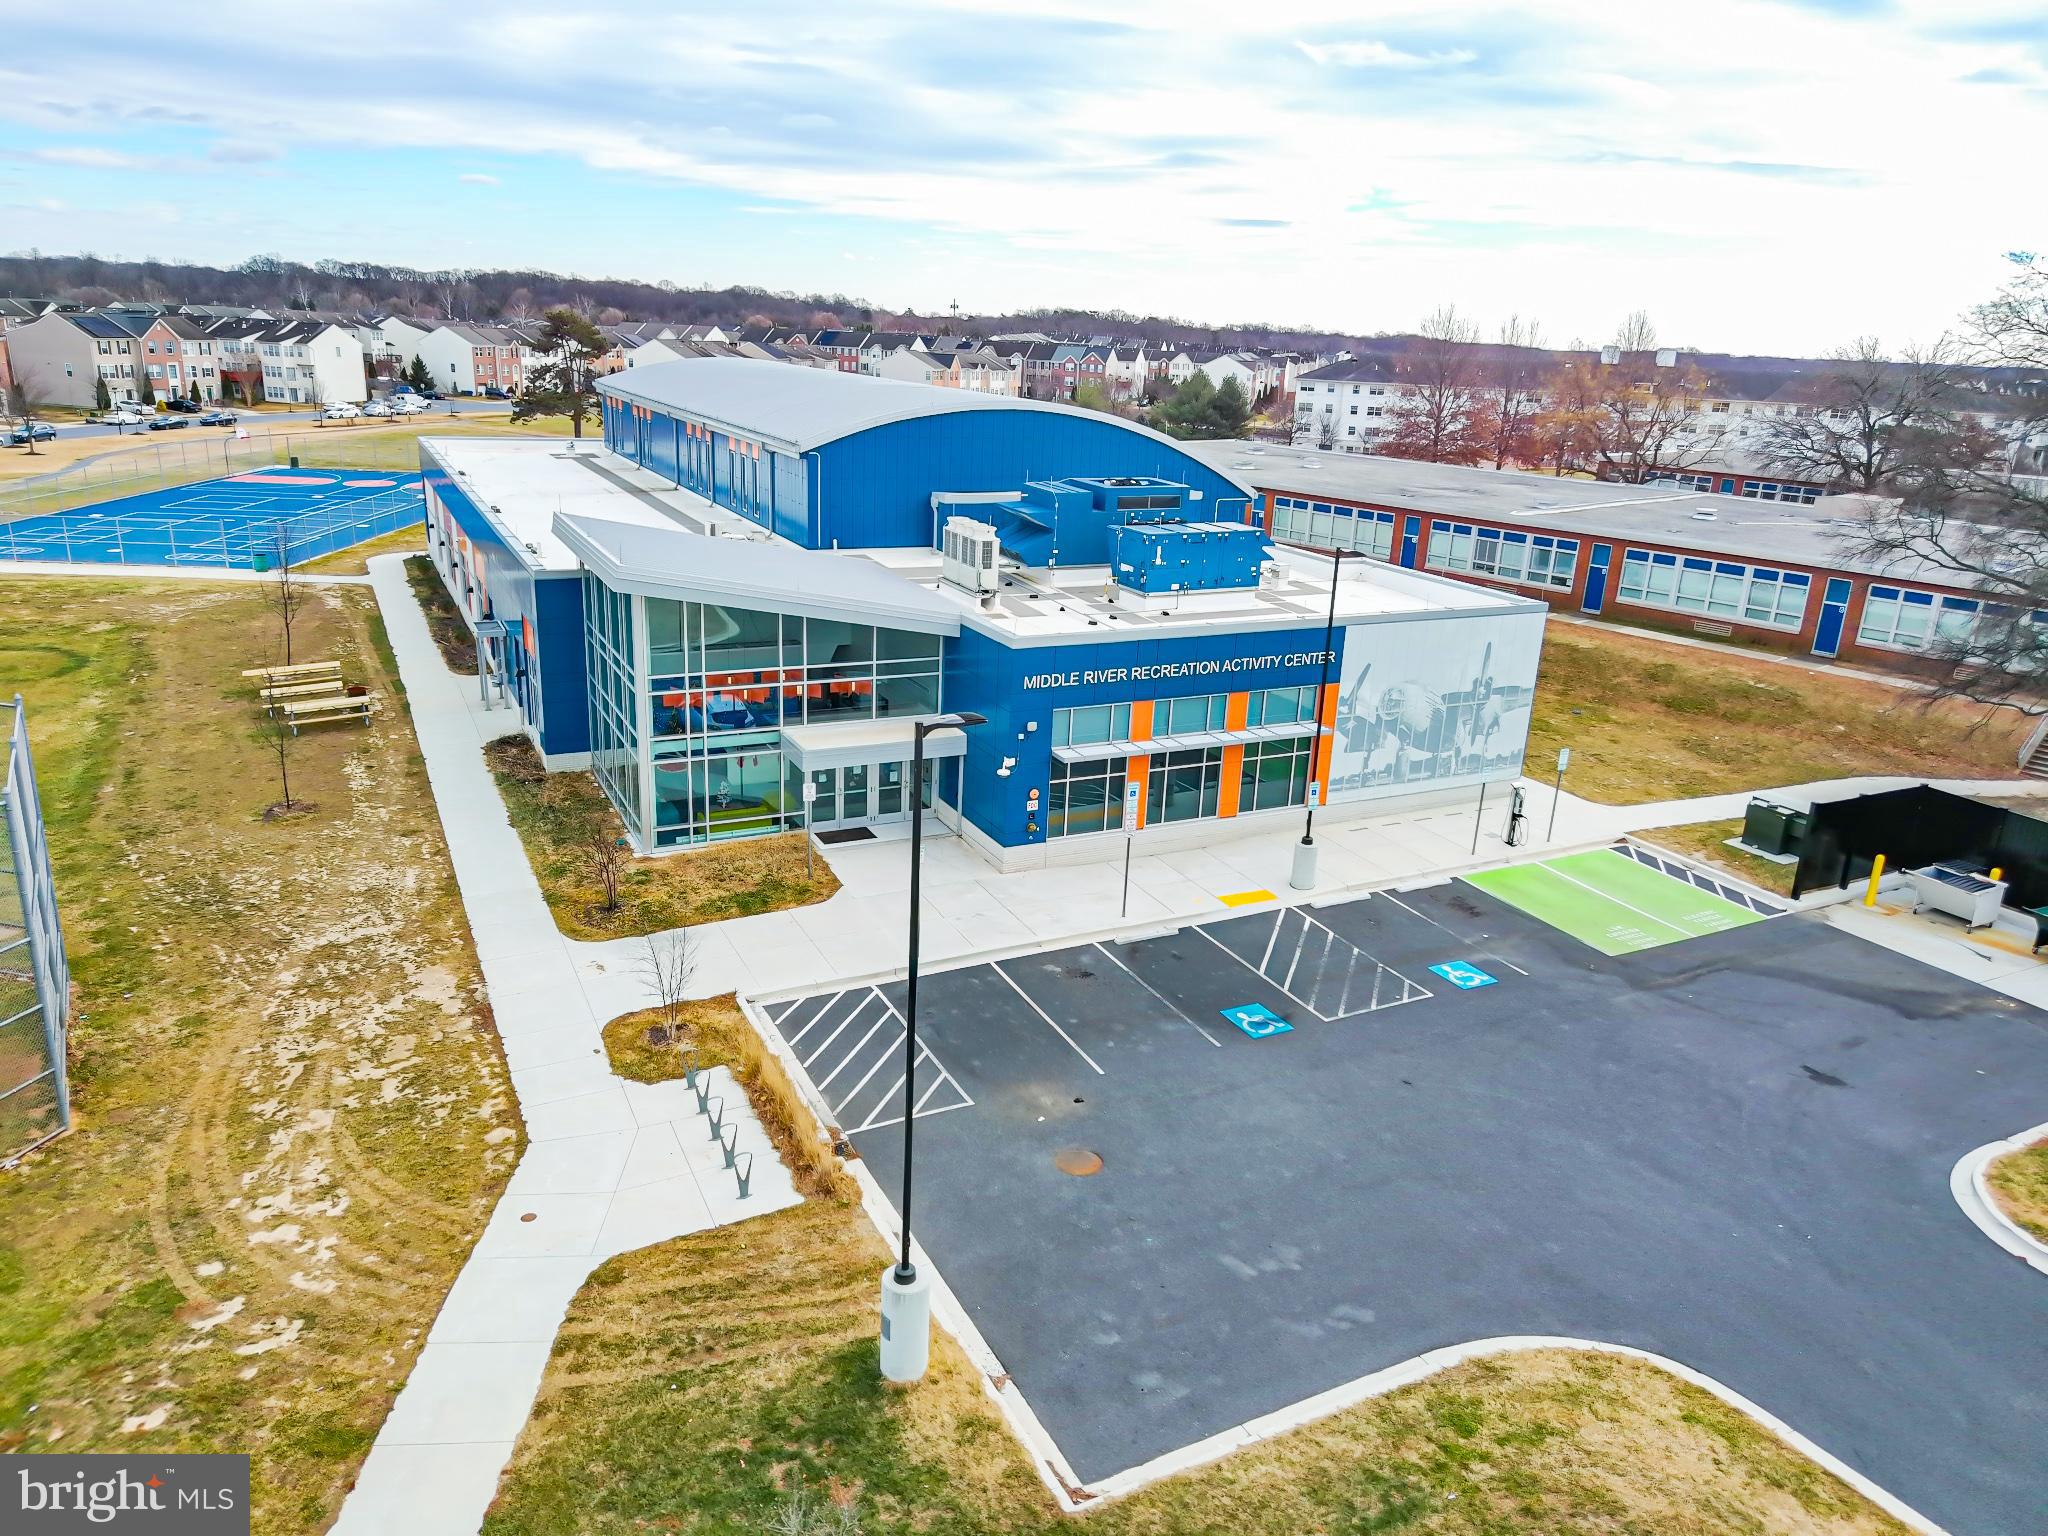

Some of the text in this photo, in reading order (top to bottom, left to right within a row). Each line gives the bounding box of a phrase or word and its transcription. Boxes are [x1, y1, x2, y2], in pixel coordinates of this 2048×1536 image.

[1024, 651, 1336, 690] MIDDLE RIVER RECREATION ACTIVITY CENTER
